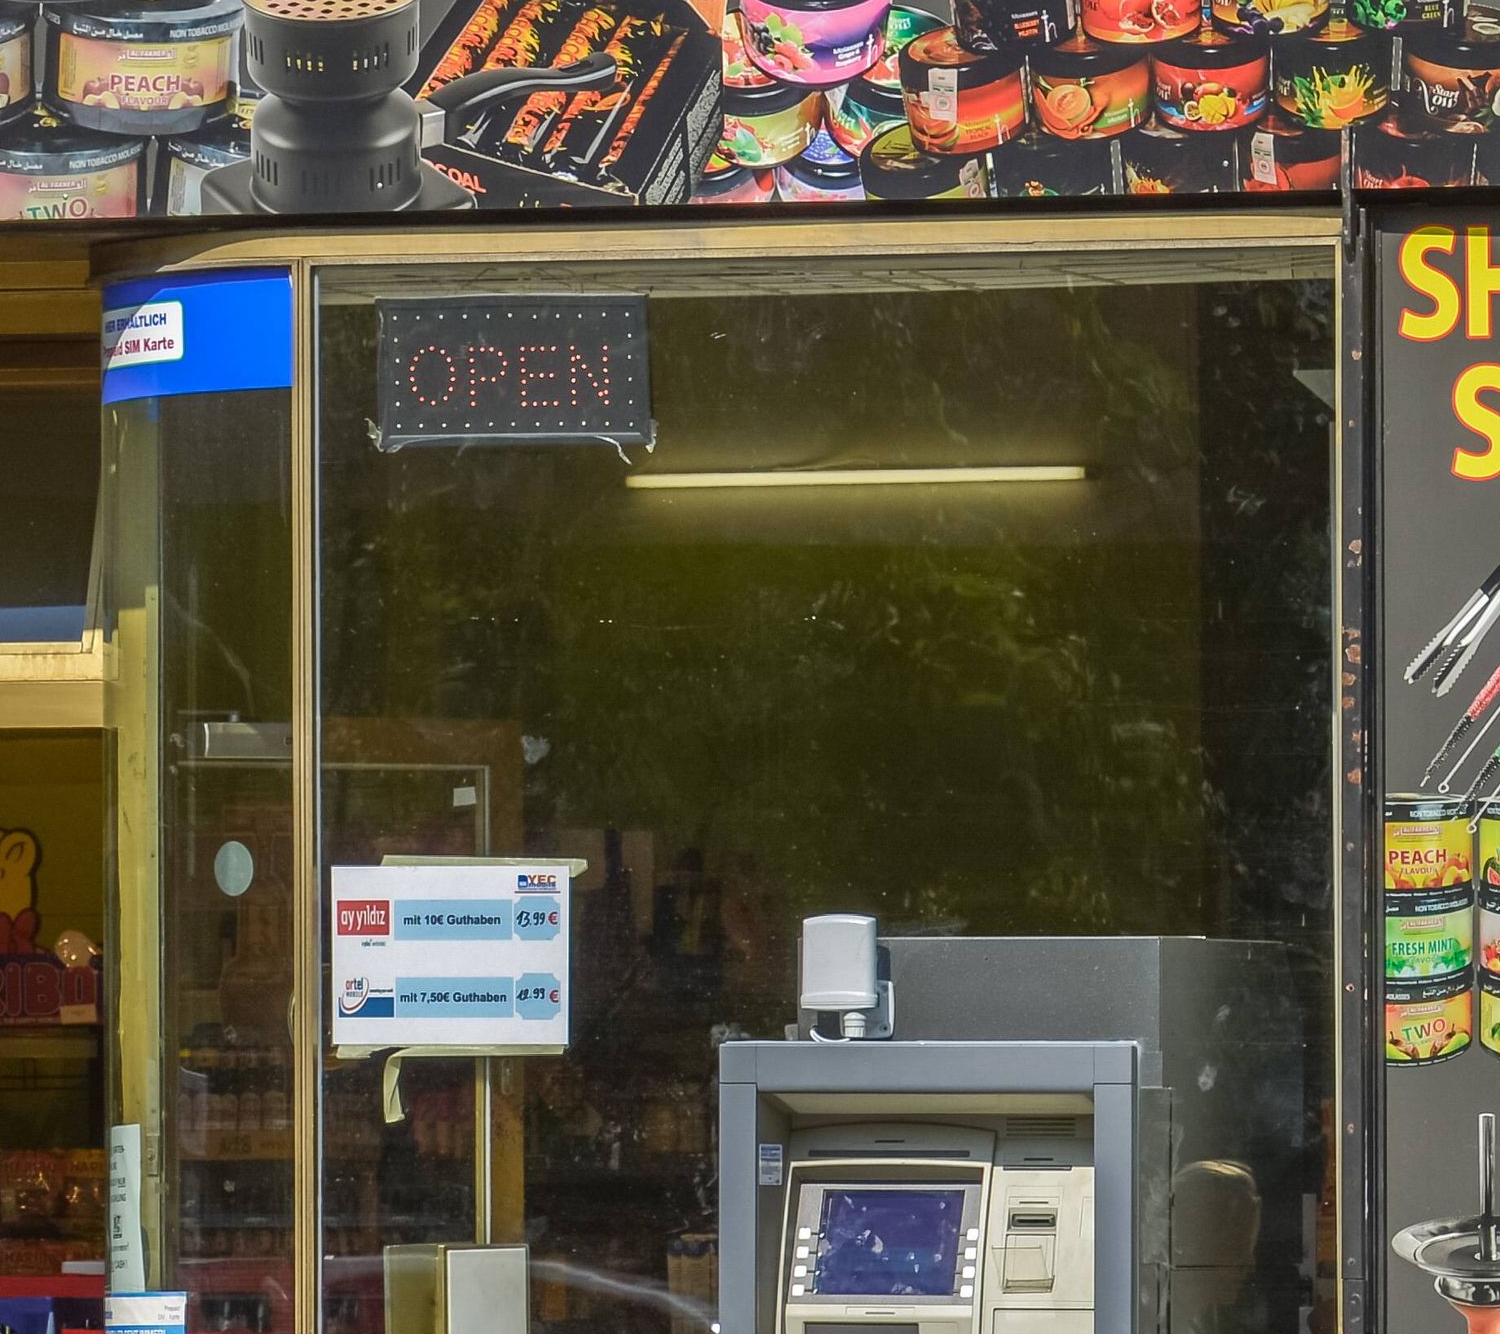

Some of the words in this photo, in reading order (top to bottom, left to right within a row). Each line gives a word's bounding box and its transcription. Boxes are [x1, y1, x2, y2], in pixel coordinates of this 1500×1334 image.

[110, 74, 183, 93] PEACH
[409, 345, 610, 407] OPEN
[1388, 848, 1447, 865] PEACH
[341, 909, 356, 931] ay
[403, 914, 421, 925] mit
[424, 914, 444, 926] 10€
[446, 913, 502, 926] Guthaben
[547, 911, 558, 926] €
[1391, 938, 1426, 956] FRESH
[1428, 937, 1455, 954] MINT
[400, 991, 418, 1003] mit
[419, 991, 450, 1005] 7,50€
[452, 990, 508, 1003] Guthaben
[548, 989, 560, 1004] €
[1402, 1018, 1447, 1043] TWO
